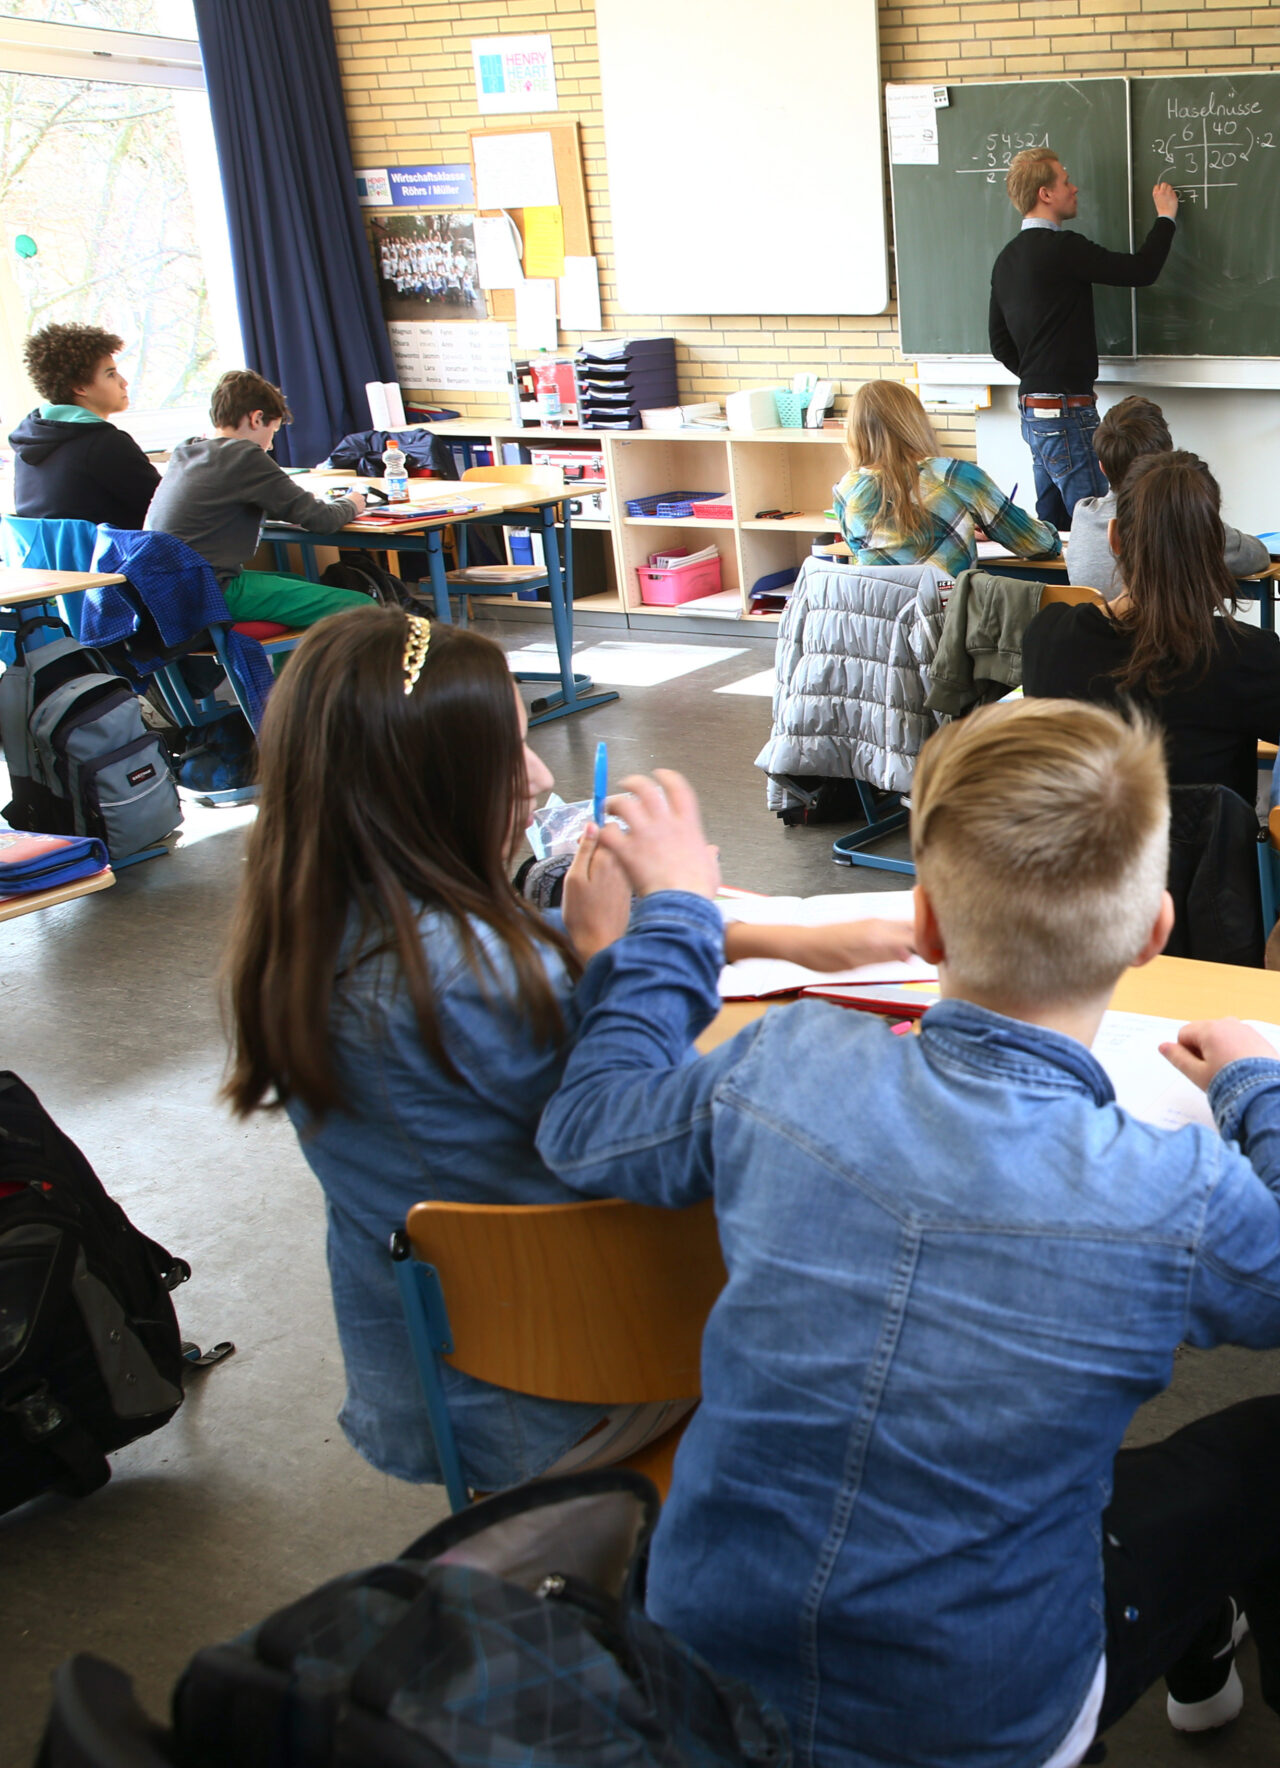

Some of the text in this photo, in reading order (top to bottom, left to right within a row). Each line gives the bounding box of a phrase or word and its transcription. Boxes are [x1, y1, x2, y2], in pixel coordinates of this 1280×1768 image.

[505, 52, 547, 66] HENRY
[507, 65, 547, 79] HEART
[1167, 91, 1263, 119] Haselnüsse
[1182, 120, 1237, 142] 6 40
[986, 131, 1050, 151] 54321
[1184, 150, 1237, 173] 3 20
[391, 171, 466, 184] Wirtschaftsklasse
[401, 186, 428, 198] Röhrs
[433, 184, 460, 196] Müller
